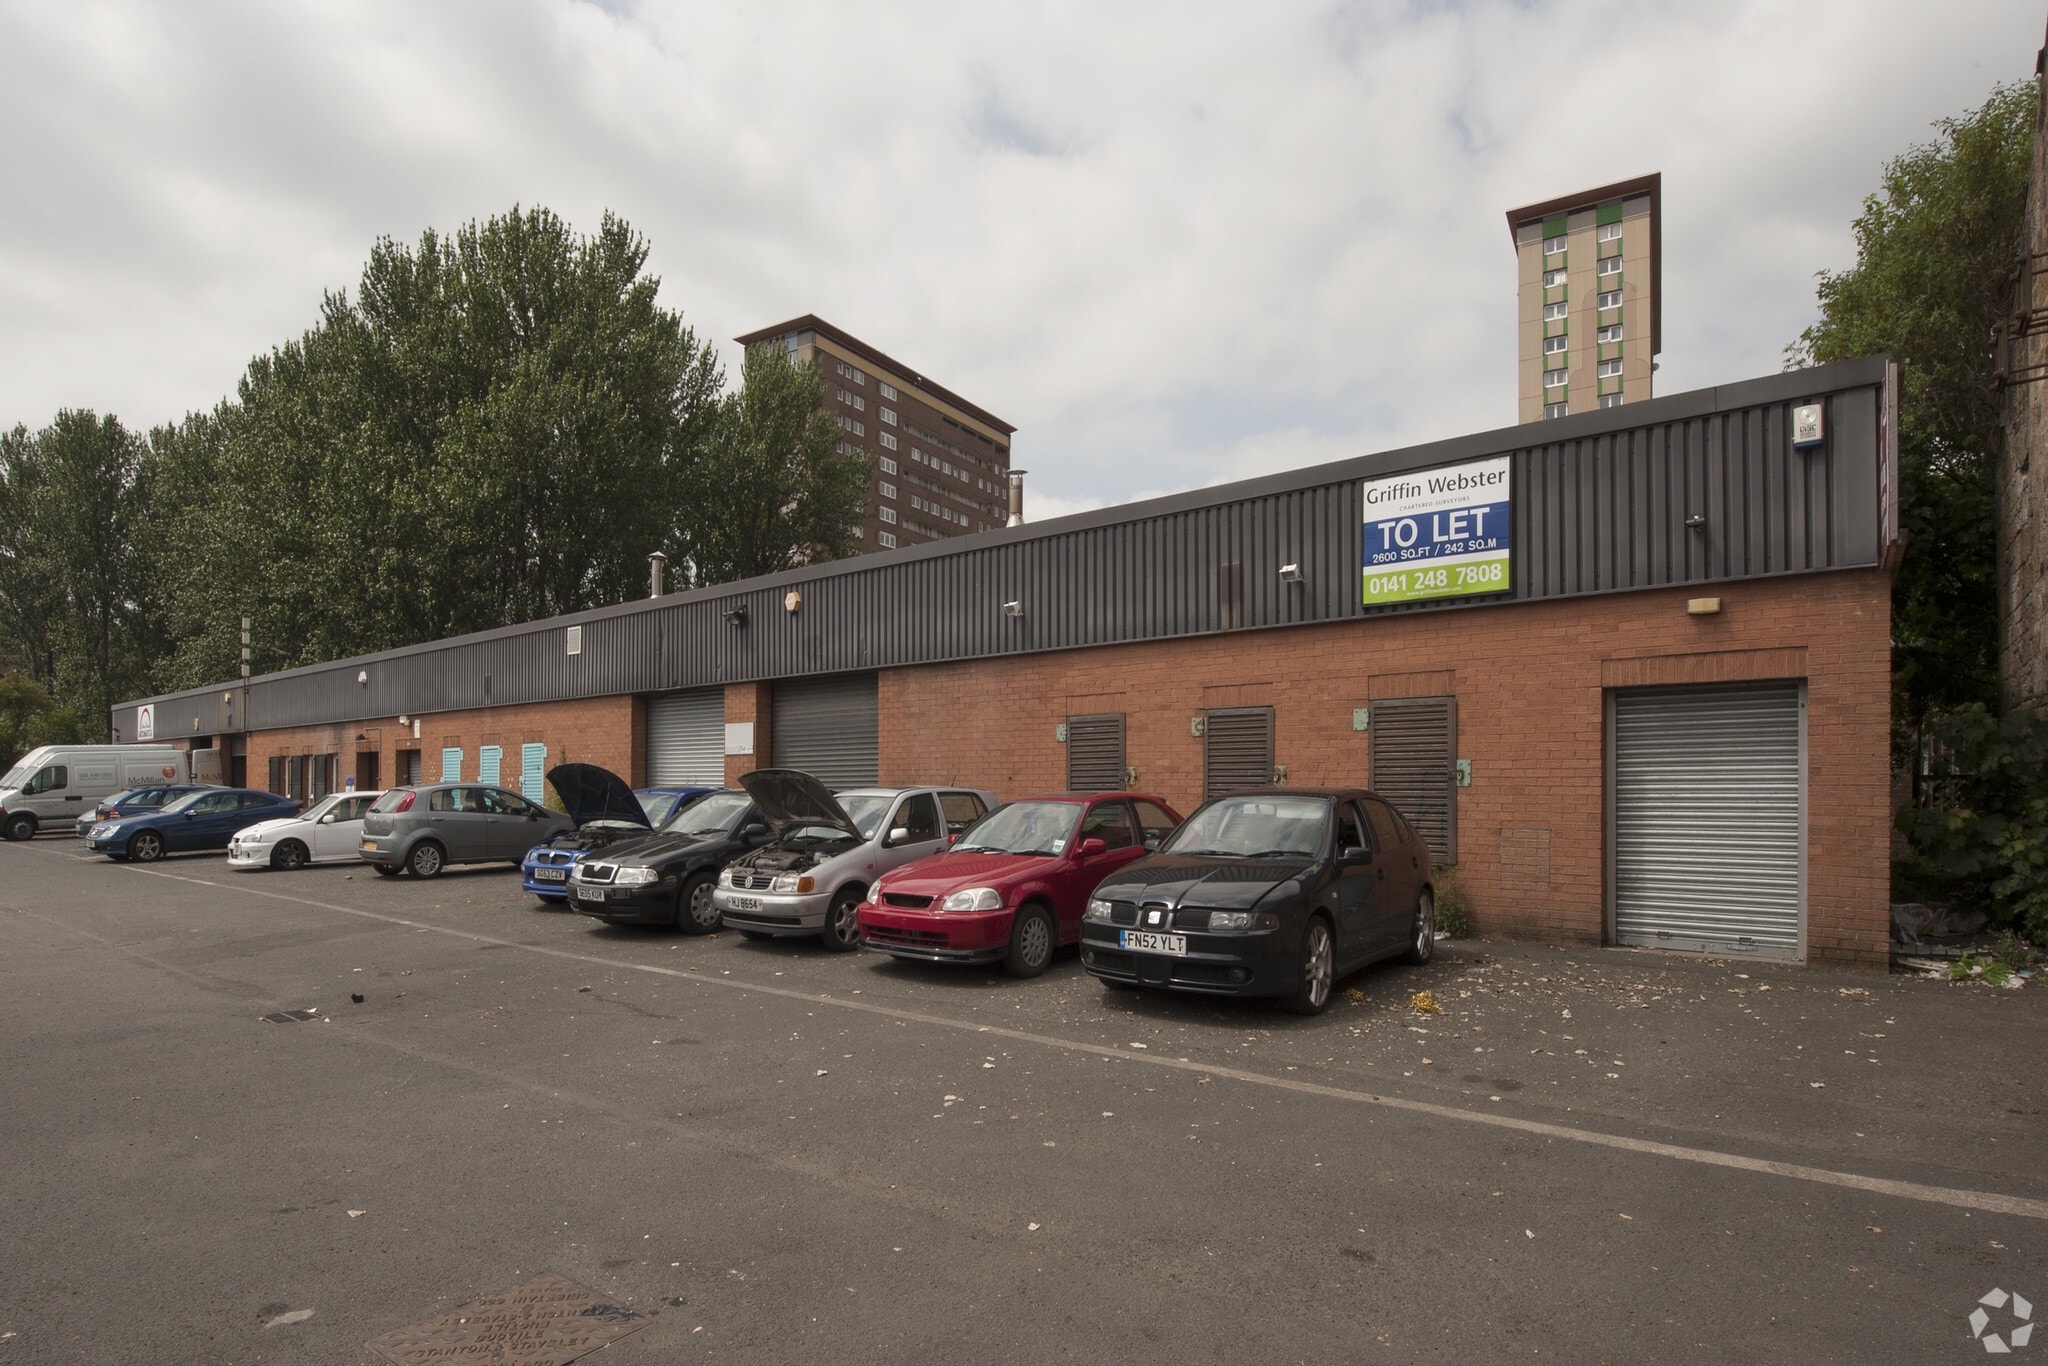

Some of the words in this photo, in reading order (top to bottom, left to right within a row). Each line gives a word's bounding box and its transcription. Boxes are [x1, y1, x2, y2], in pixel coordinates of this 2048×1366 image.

[1367, 483, 1421, 504] Griffin
[1428, 469, 1505, 494] Webster
[1399, 501, 1433, 511] CHARTERED
[1435, 496, 1470, 506] SURVEYORS
[1378, 518, 1418, 550] TO
[1433, 507, 1490, 543] LET
[1372, 552, 1397, 564] 2600
[1400, 546, 1431, 559] SQ.FT
[1445, 542, 1464, 554] 242
[1468, 535, 1497, 550] SQ.M
[1369, 574, 1407, 594] 0141
[1414, 569, 1447, 590] 248
[1456, 563, 1502, 585] 7808
[128, 776, 165, 785] McMillan
[1127, 932, 1157, 949] FN52
[1160, 935, 1184, 952] YLT
